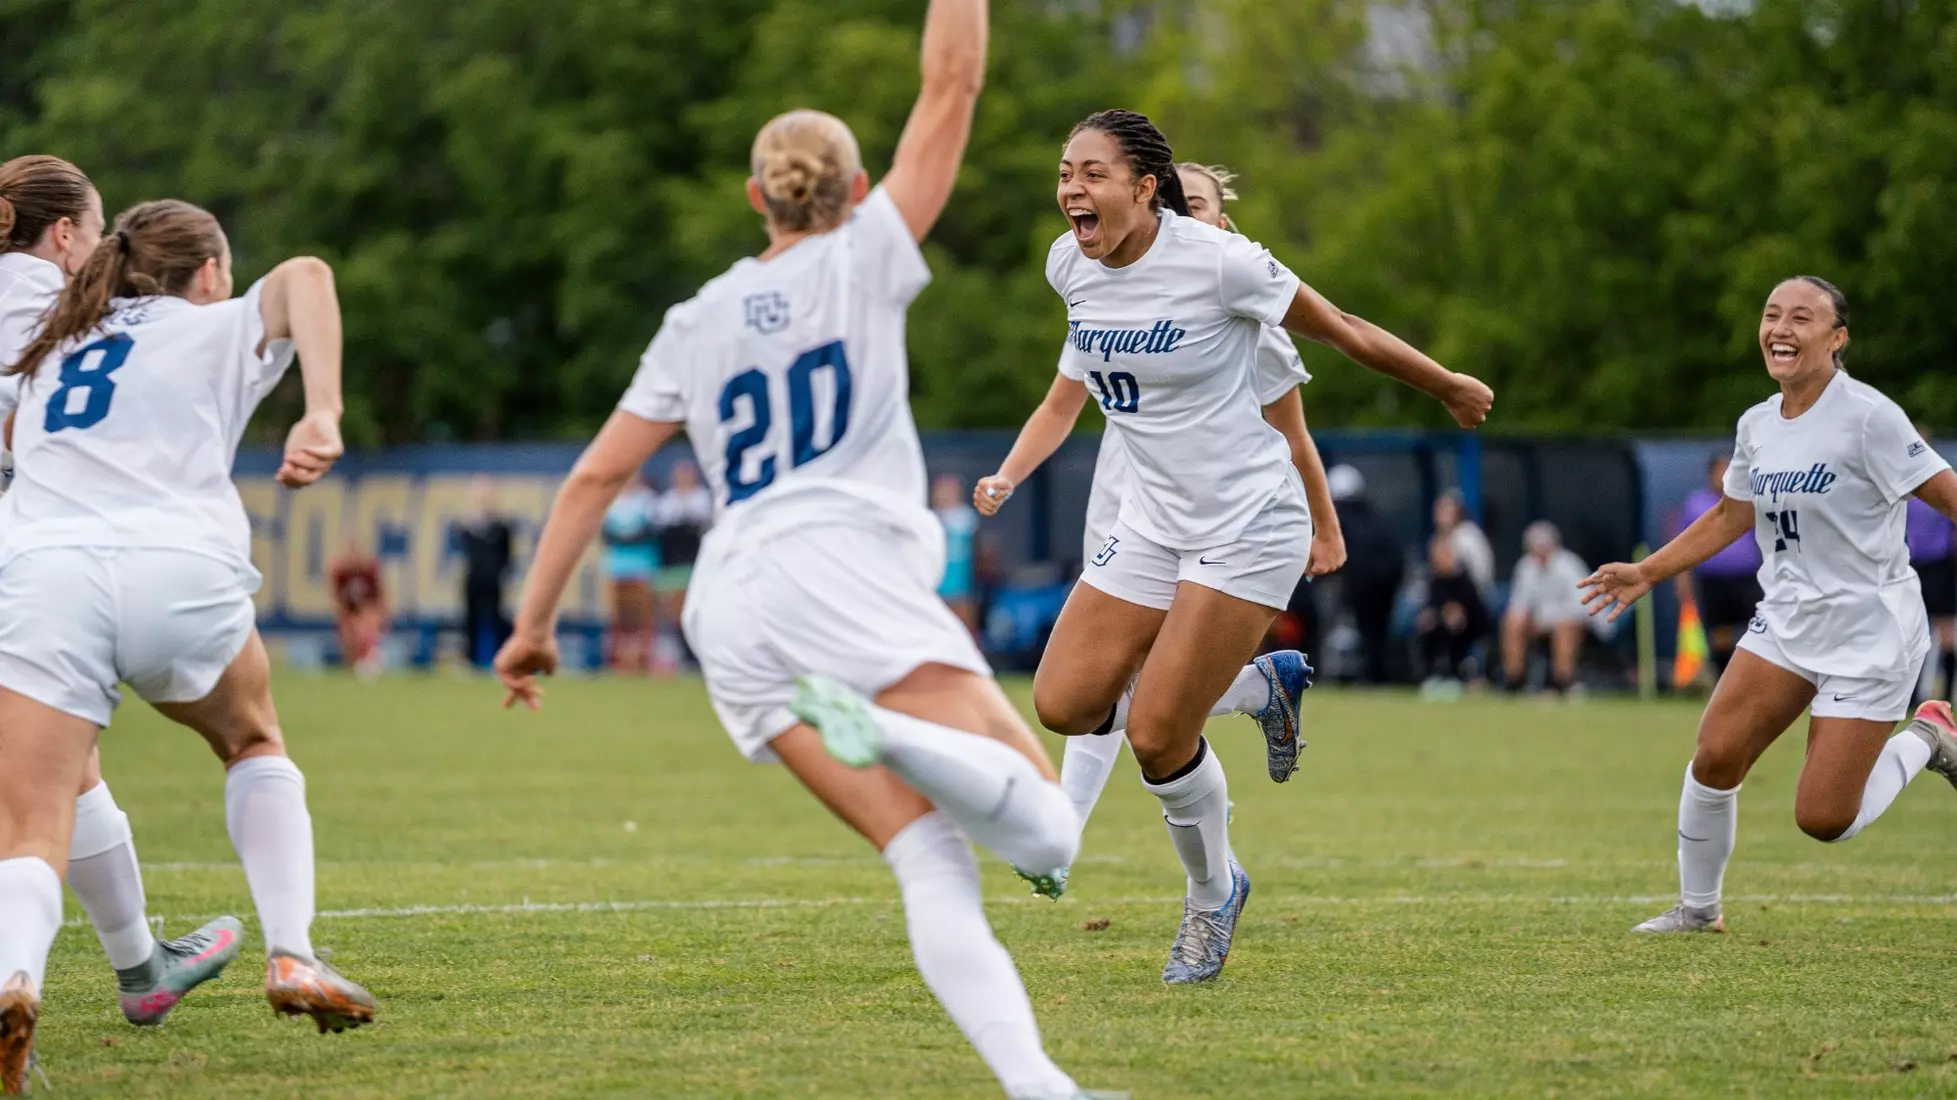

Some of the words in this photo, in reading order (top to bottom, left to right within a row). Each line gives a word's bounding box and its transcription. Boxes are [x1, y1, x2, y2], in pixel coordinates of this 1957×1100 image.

[43, 331, 135, 433] 8
[717, 339, 854, 507] 20
[1090, 370, 1139, 413] 10
